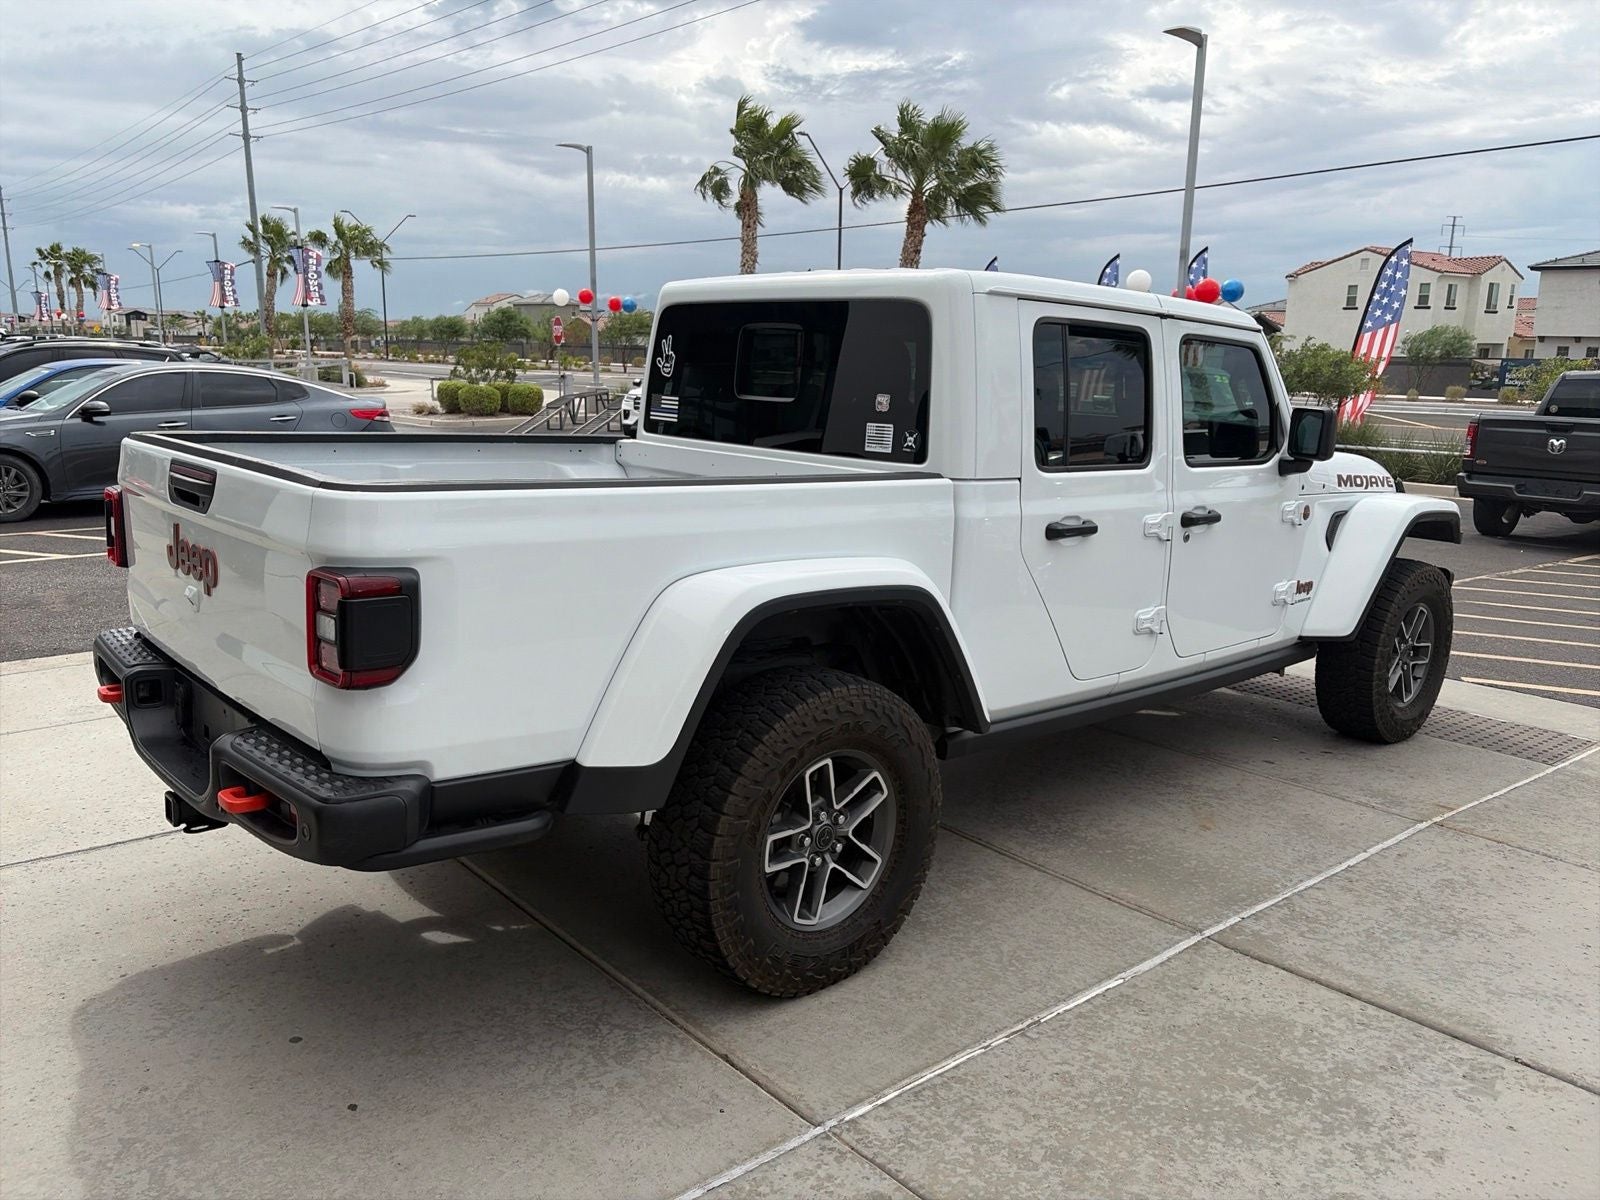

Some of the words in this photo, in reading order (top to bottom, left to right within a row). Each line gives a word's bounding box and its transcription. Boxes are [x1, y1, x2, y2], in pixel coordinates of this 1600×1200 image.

[1336, 474, 1395, 490] MOJAVE
[167, 523, 219, 597] Jeep
[1293, 580, 1314, 595] Jeep
